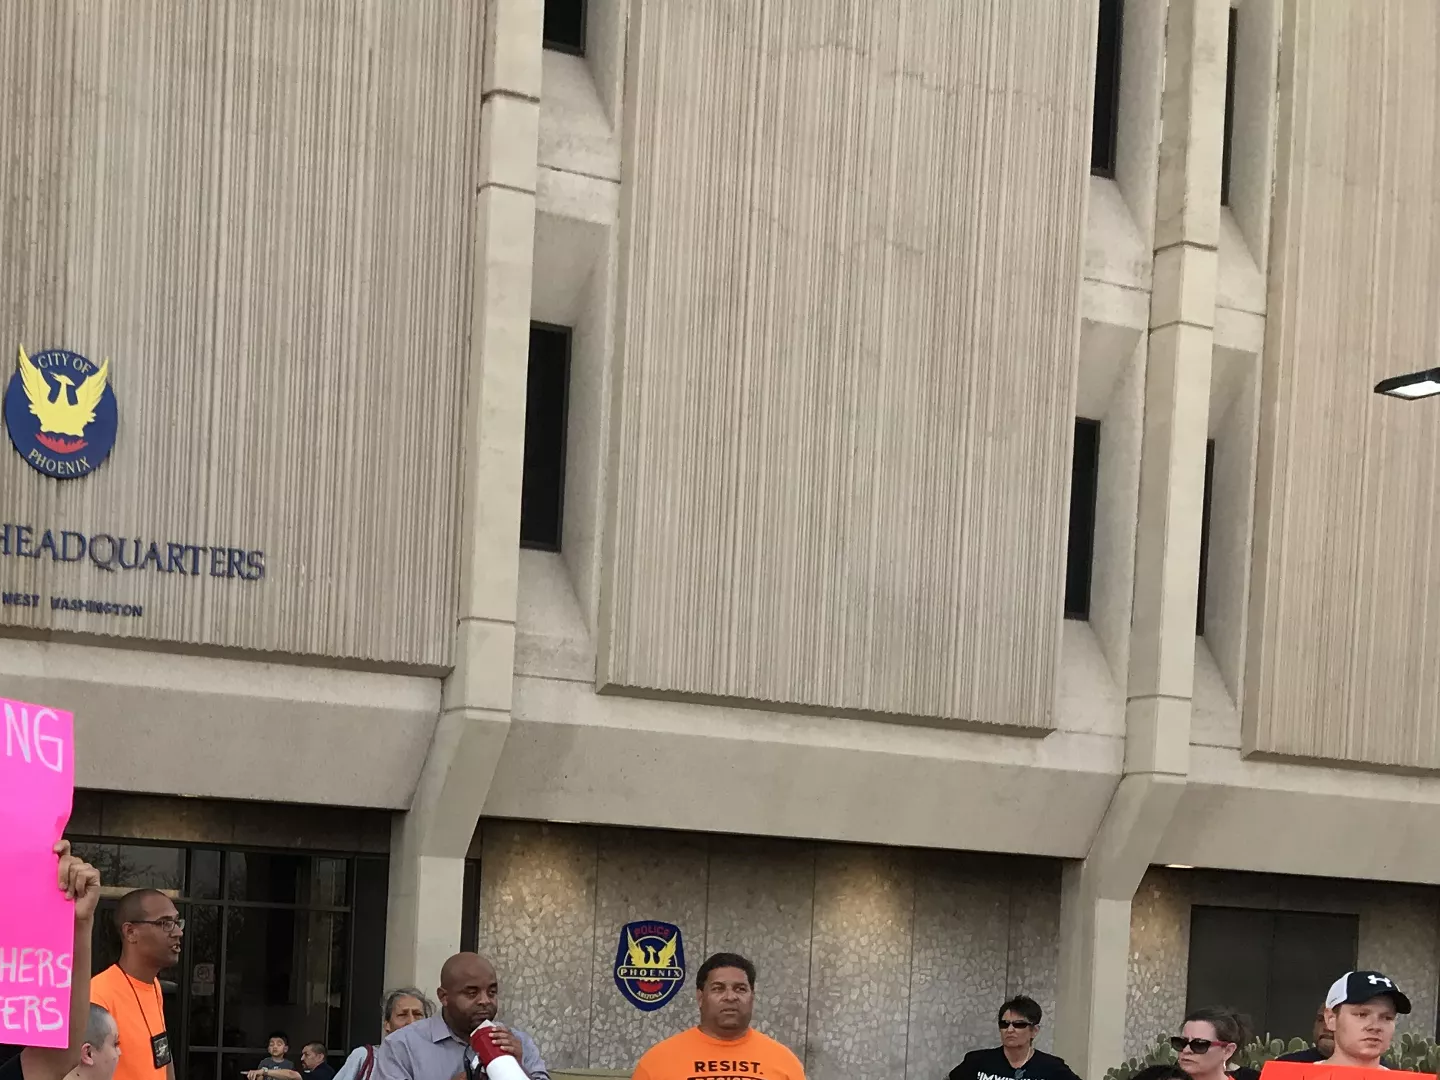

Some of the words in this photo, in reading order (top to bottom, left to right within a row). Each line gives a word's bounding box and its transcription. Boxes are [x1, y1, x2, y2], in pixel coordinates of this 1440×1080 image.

[38, 352, 69, 368] CITY
[72, 358, 92, 373] OF
[28, 448, 90, 475] PHOENIX
[2, 591, 40, 607] WEST
[50, 596, 142, 617] WASHINGTON
[634, 925, 670, 938] POLICE
[620, 969, 680, 977] PHOENIX
[637, 990, 662, 1000] ARIZONA
[694, 1060, 763, 1075] RESIST.
